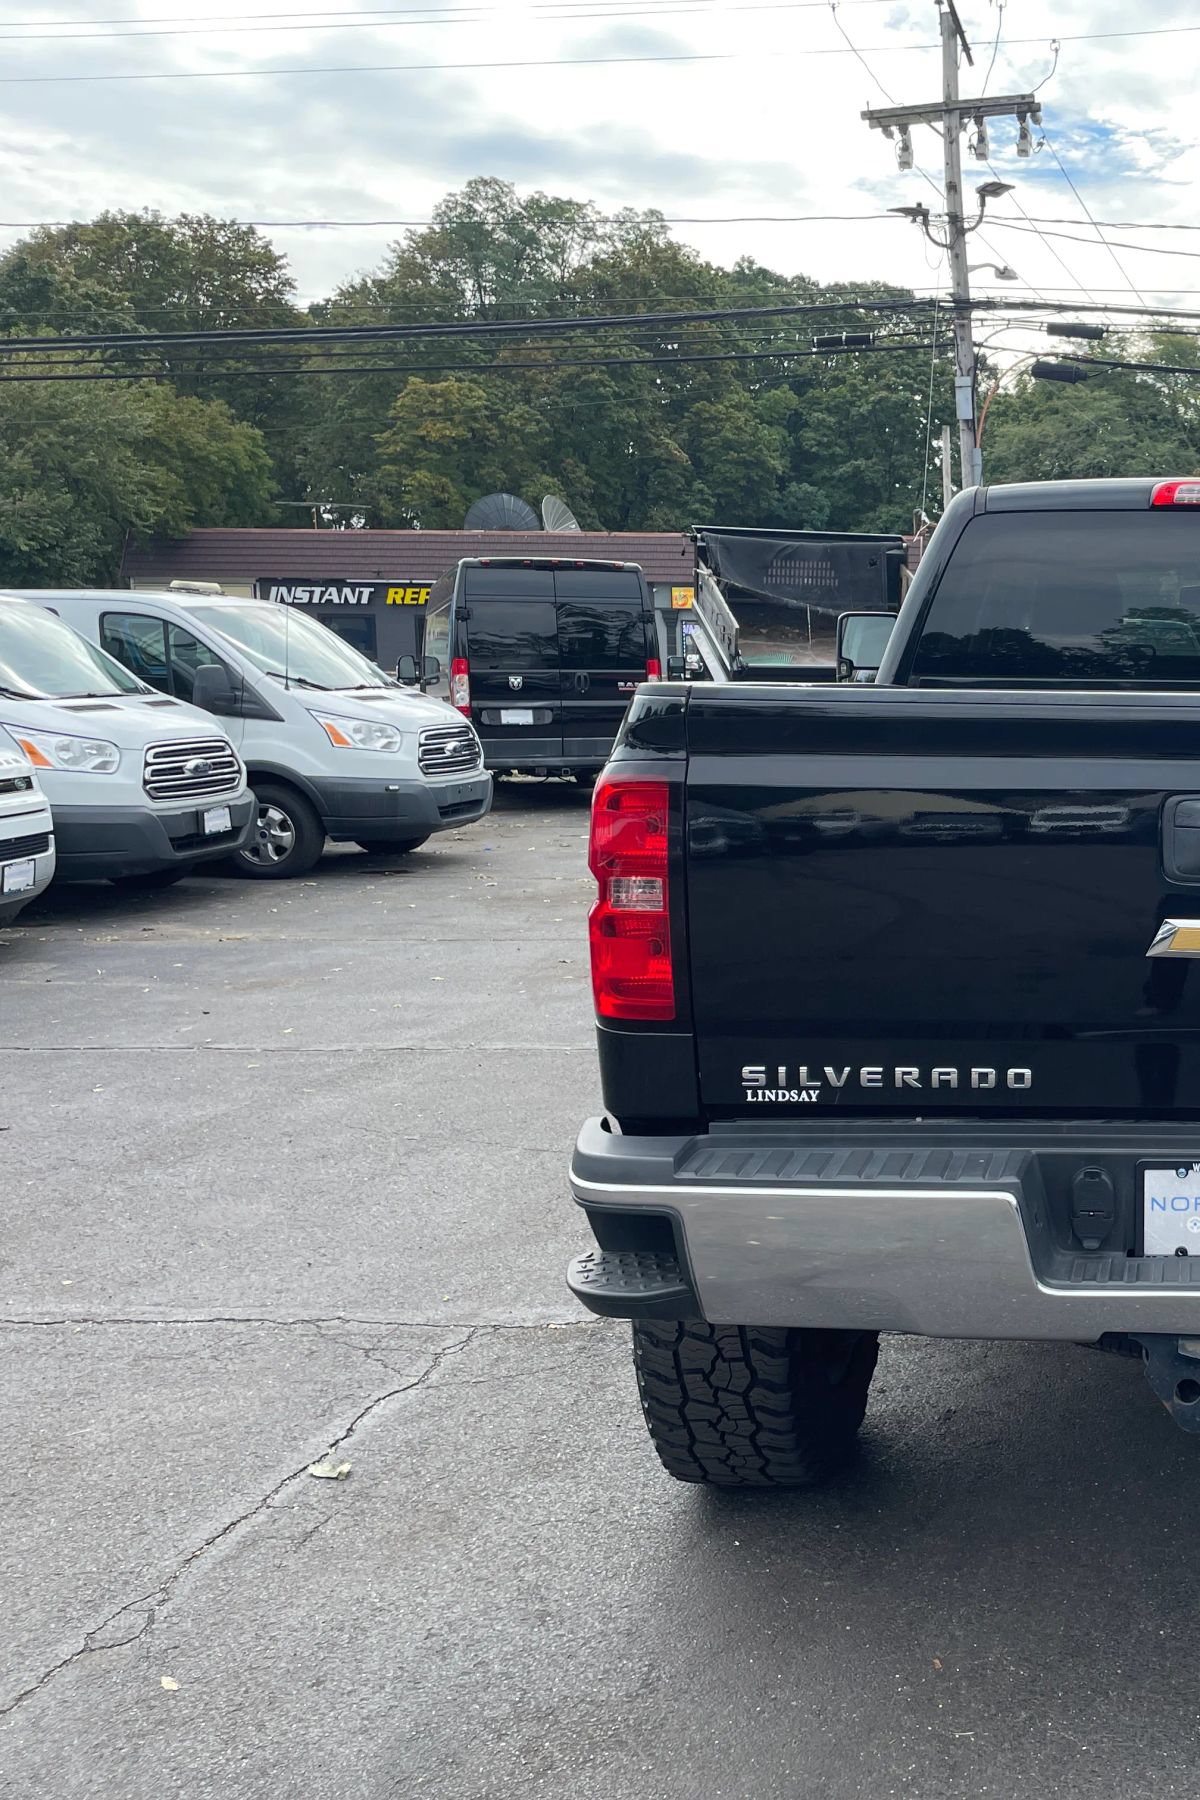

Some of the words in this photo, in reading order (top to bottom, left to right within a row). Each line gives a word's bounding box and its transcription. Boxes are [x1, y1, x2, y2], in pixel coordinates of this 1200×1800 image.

[269, 586, 374, 604] INSTANT
[741, 1066, 1032, 1089] SILVERADO
[745, 1089, 820, 1102] LINDSAY
